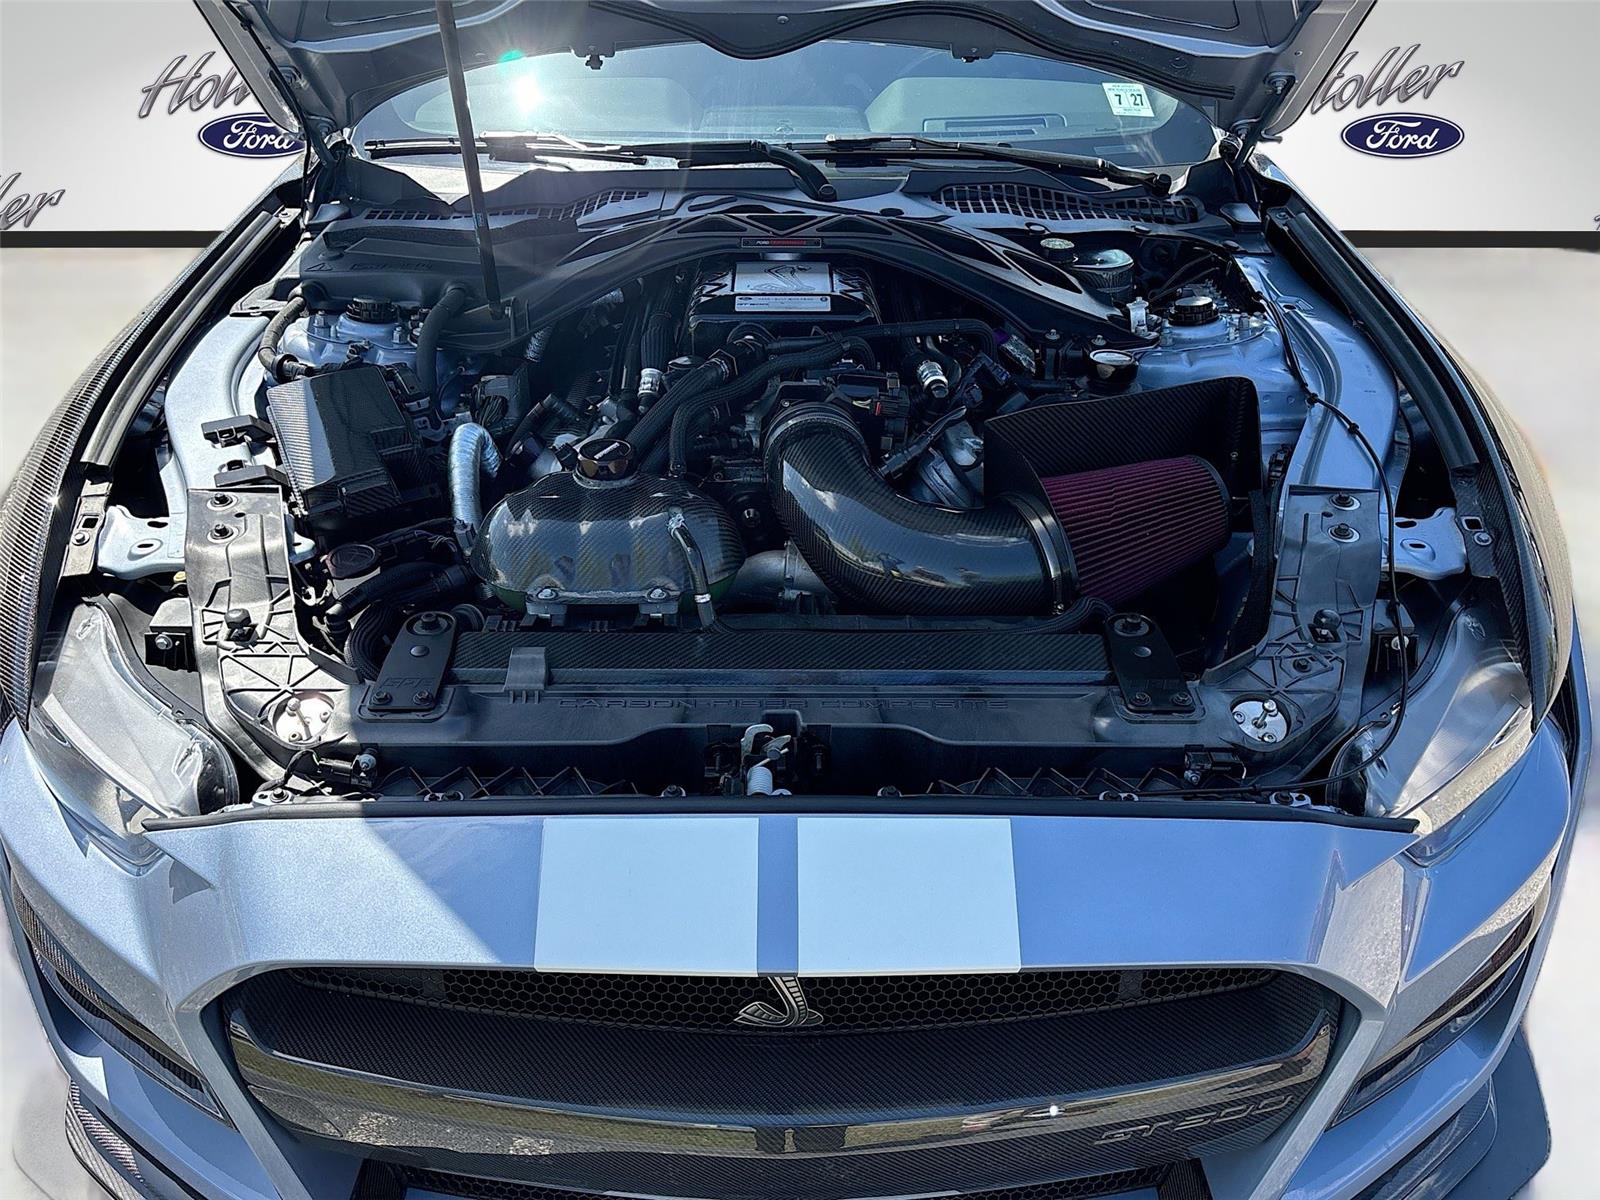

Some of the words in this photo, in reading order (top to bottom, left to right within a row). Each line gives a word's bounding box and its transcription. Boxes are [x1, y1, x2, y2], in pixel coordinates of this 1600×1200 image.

[1114, 93, 1122, 106] 7
[1130, 93, 1144, 106] 27
[1365, 119, 1440, 150] Ford
[559, 698, 697, 710] CARBON
[1094, 1095, 1293, 1146] GT500
